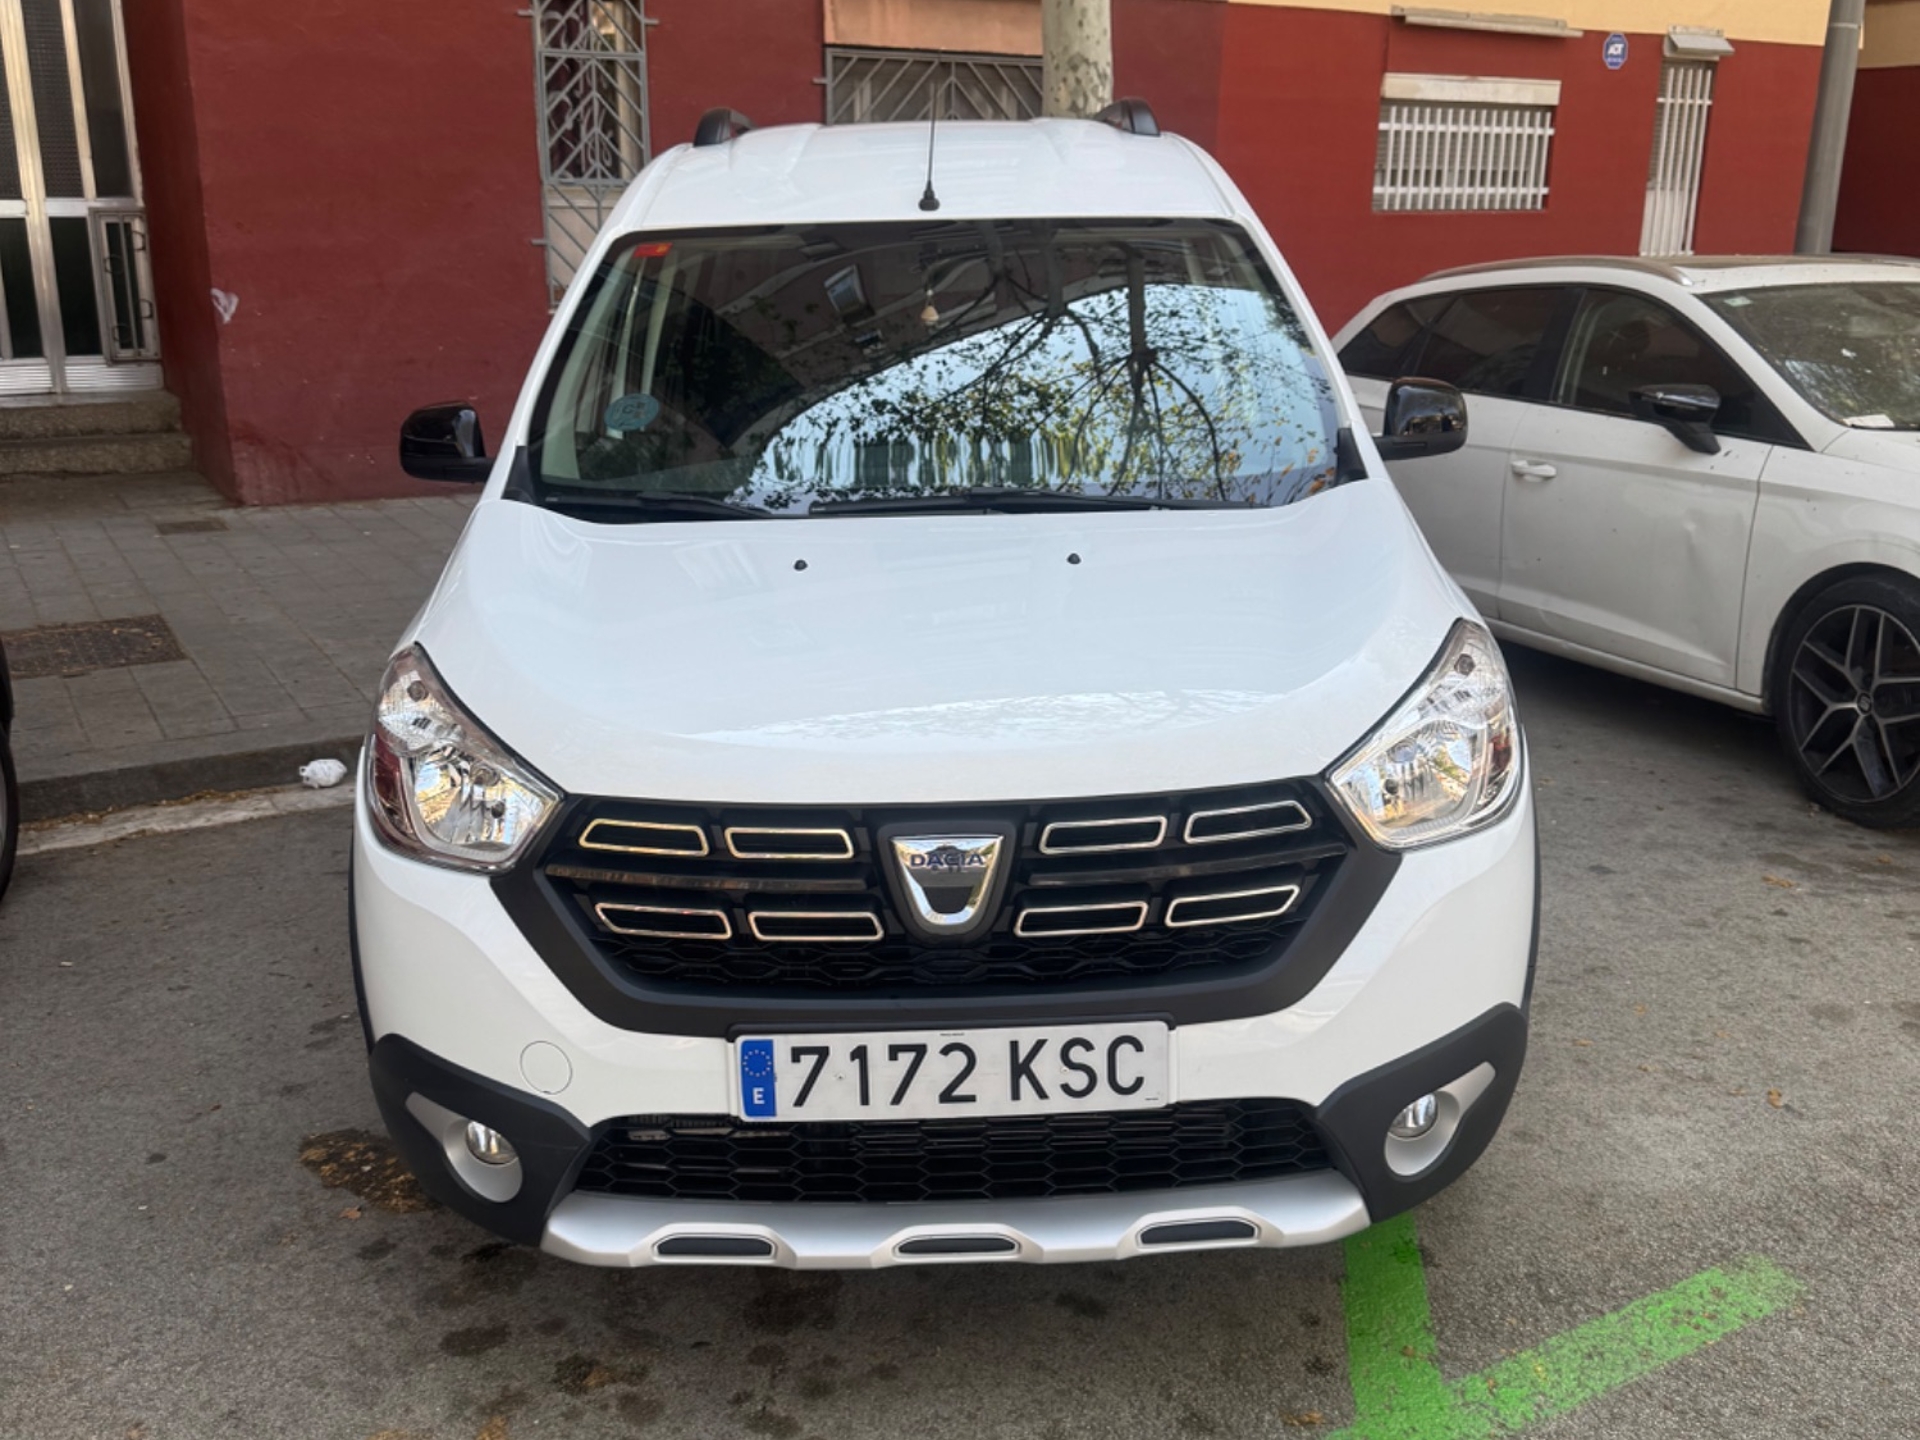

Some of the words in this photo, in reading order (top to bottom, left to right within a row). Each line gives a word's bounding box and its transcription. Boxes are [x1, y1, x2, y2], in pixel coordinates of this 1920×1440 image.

[910, 853, 984, 866] DACIA
[791, 1042, 977, 1107] 7172
[1009, 1035, 1145, 1101] KSC
[753, 1087, 765, 1104] E
